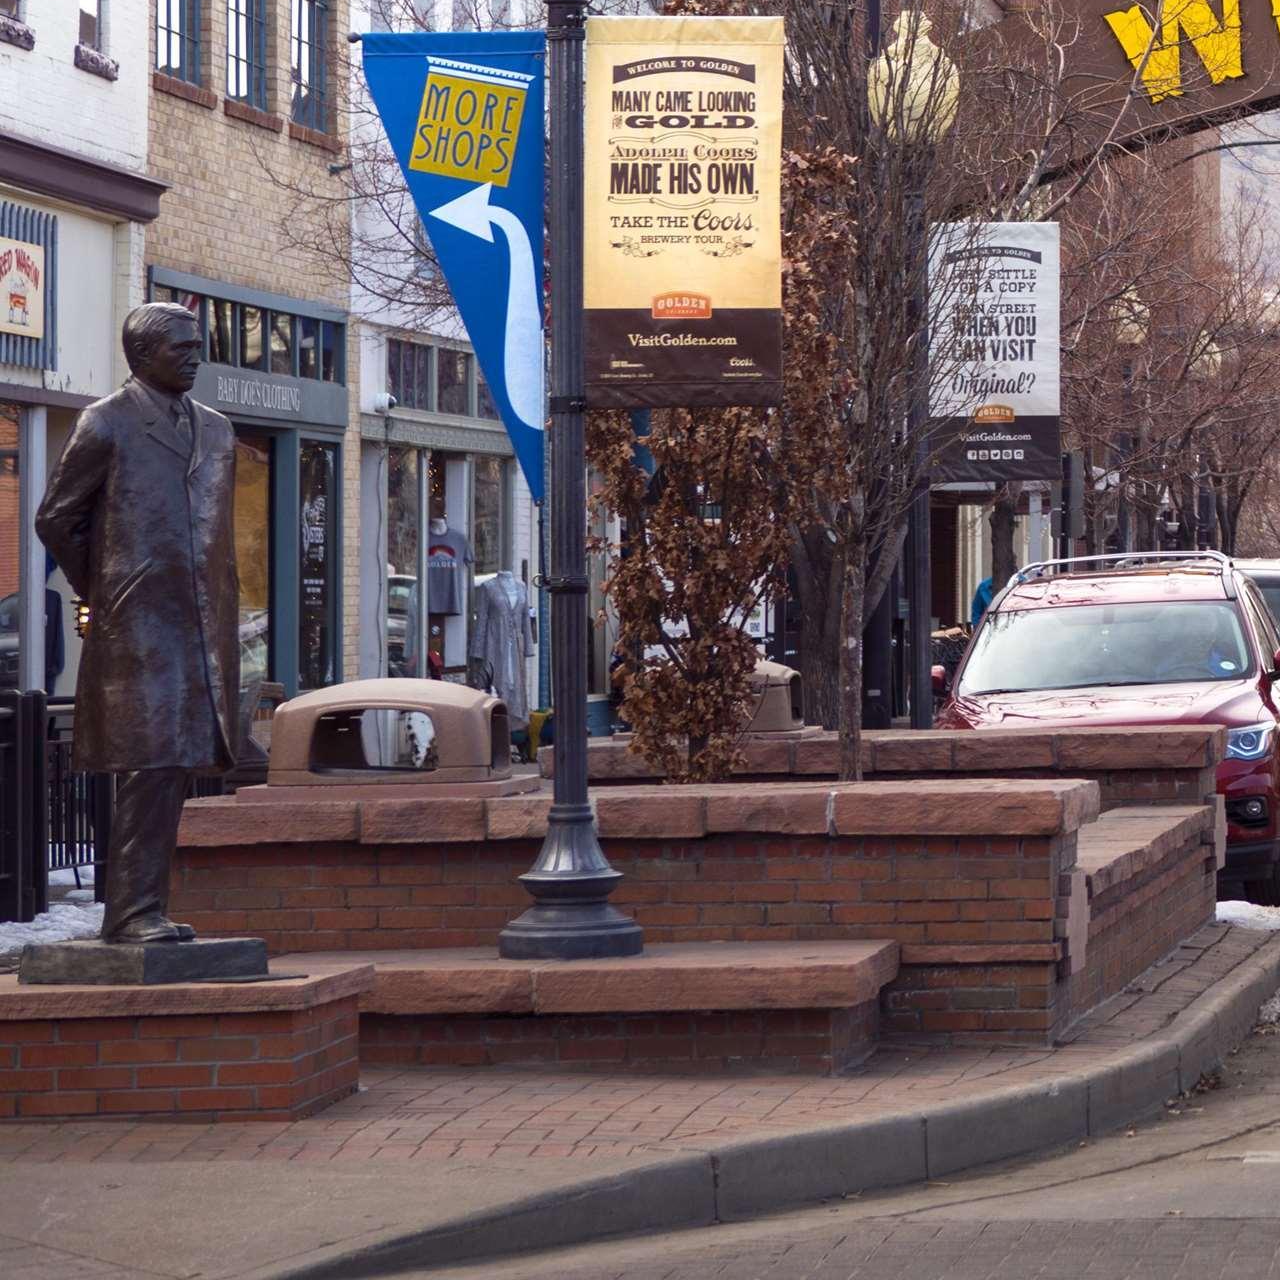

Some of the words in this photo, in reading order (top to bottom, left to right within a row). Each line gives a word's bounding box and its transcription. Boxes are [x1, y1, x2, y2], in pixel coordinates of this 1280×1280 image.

[626, 60, 676, 75] WELCOME
[681, 60, 695, 68] TO
[700, 60, 741, 74] GOLDEN
[424, 83, 518, 134] MORE
[612, 91, 651, 112] MANY
[656, 91, 693, 112] CAME
[699, 91, 756, 112] LOOKING
[625, 115, 758, 129] GOLD.
[415, 124, 512, 173] SHOPS
[610, 145, 689, 161] ADOLPH
[694, 144, 758, 161] COORS
[610, 163, 662, 194] MADE
[669, 163, 702, 194] HIS
[707, 163, 759, 194] OWN.
[610, 216, 653, 228] TAKE
[657, 216, 689, 228] THE
[691, 209, 753, 231] Coors
[640, 235, 691, 244] BREWERY
[988, 269, 1036, 280] SETTLE
[999, 282, 1036, 293] COPY
[657, 296, 706, 309] GOLDEN
[989, 304, 1036, 314] STREET
[1006, 316, 1036, 337] YOU
[628, 333, 737, 347] VisitGolden.com
[990, 339, 1036, 361] VISIT
[217, 376, 239, 403] BABY
[262, 383, 300, 412] CLOTHING
[952, 372, 1036, 402] Original?
